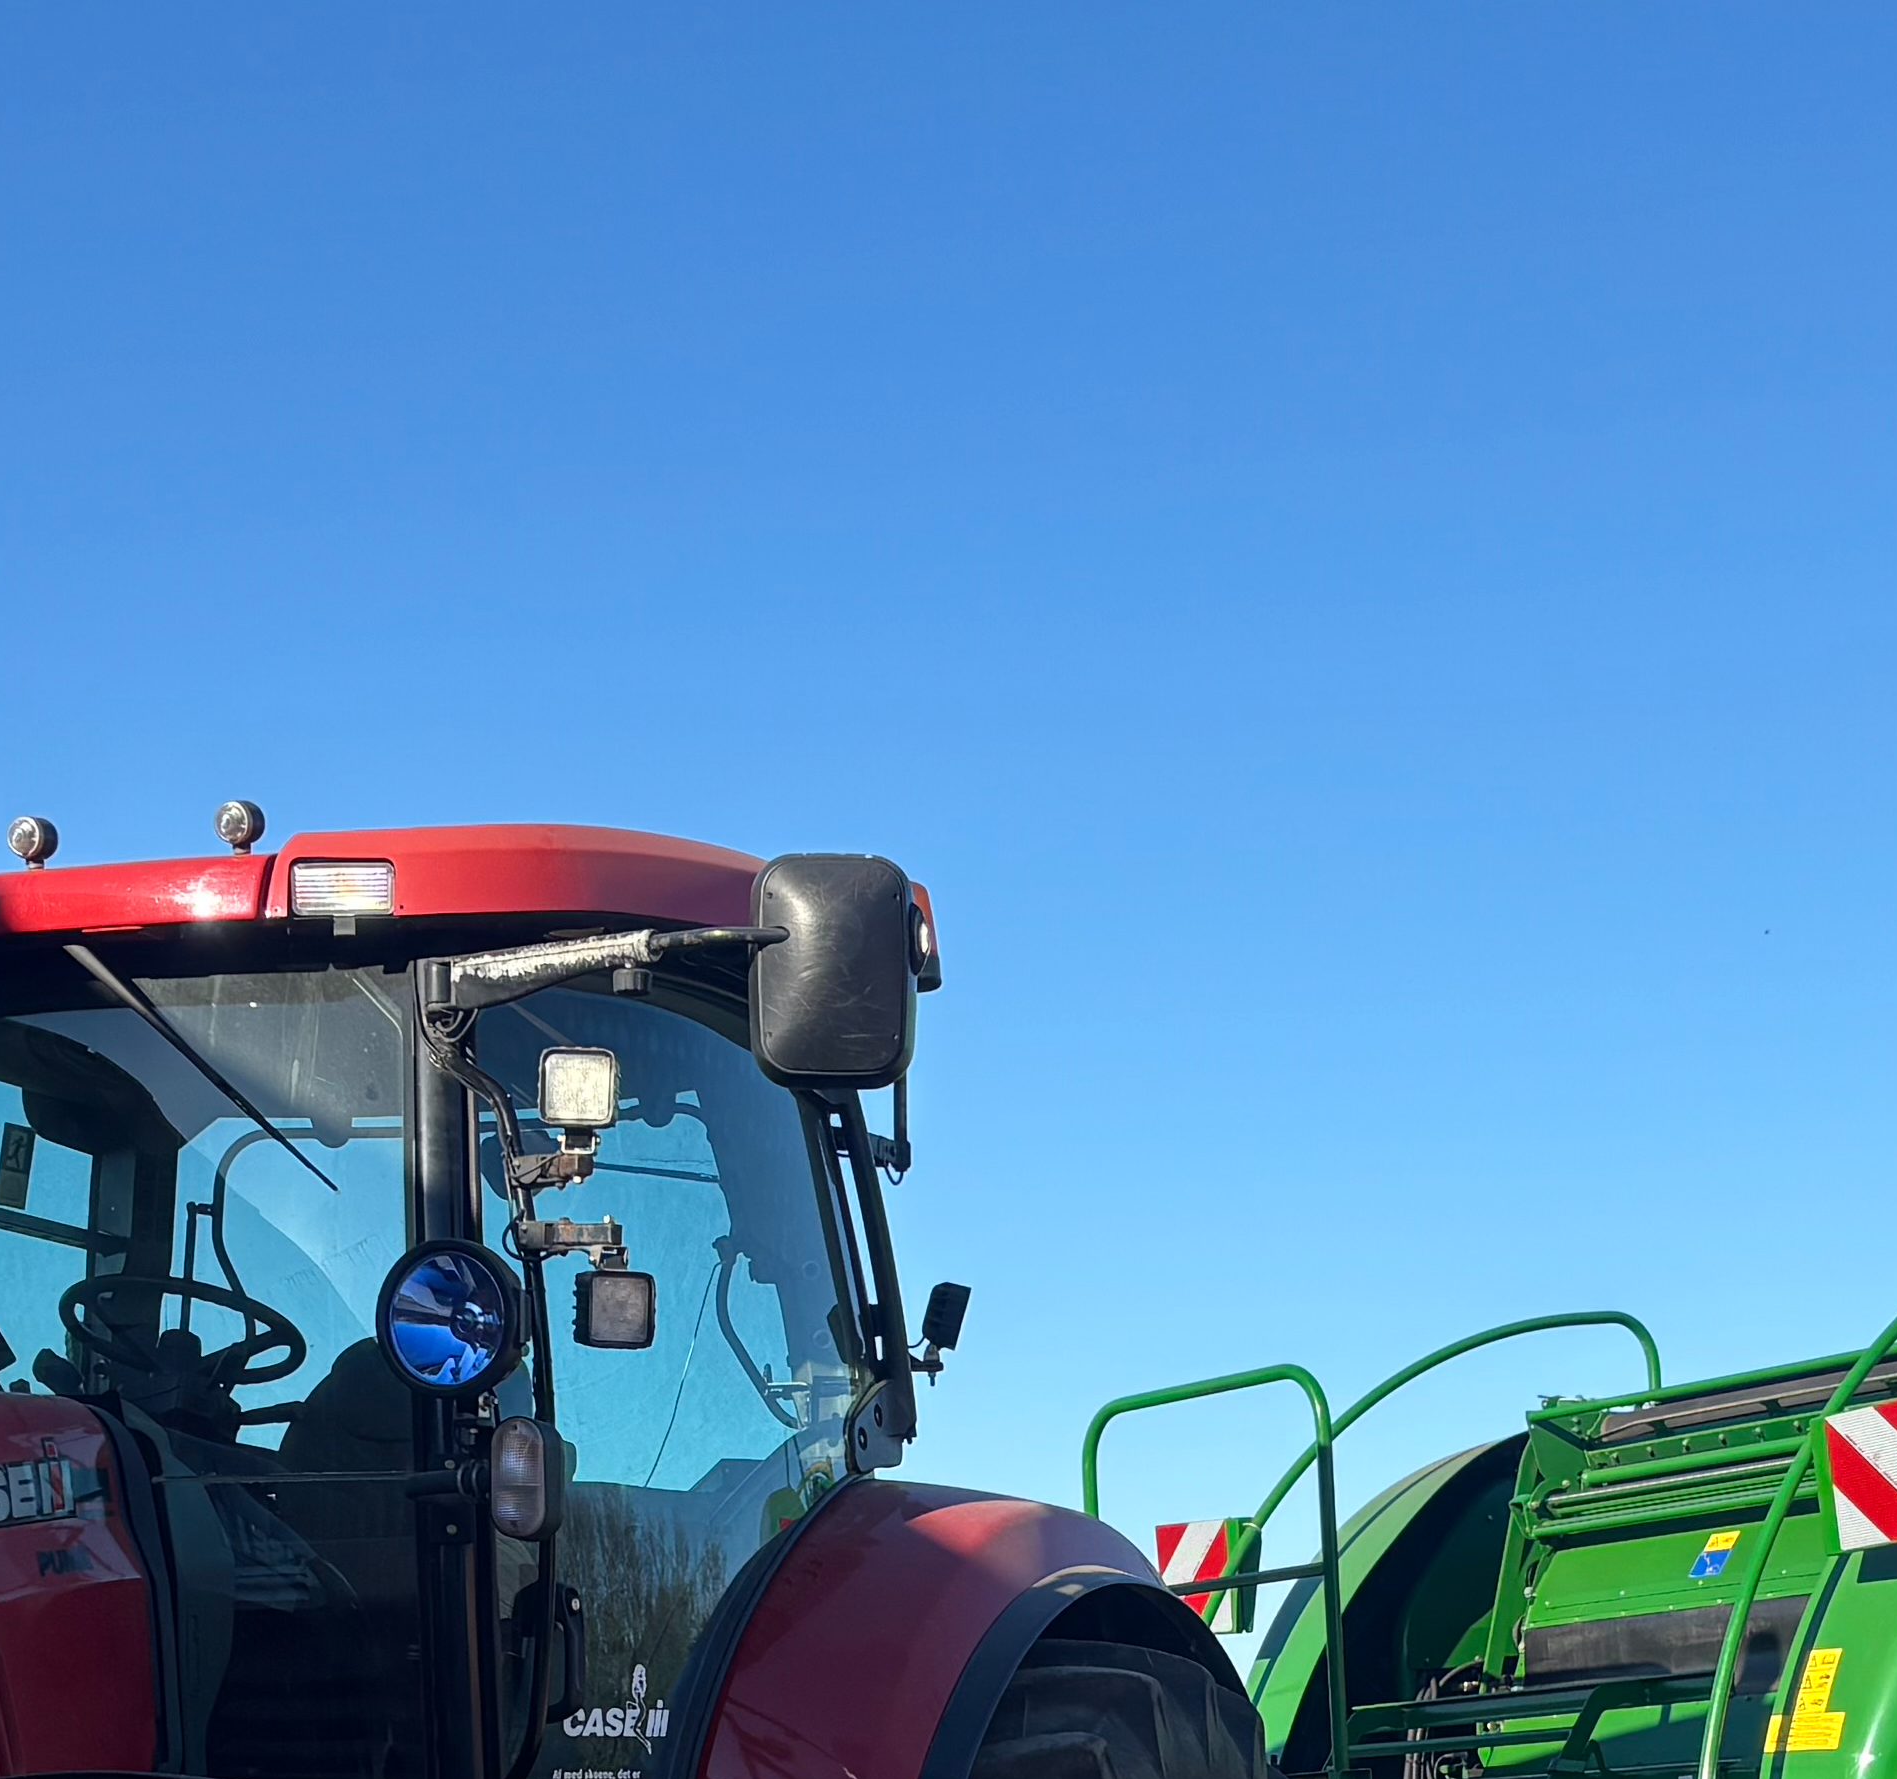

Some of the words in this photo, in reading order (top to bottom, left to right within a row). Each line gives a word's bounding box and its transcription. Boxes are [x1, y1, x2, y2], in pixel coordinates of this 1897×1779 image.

[563, 1706, 639, 1738] CASE
[617, 1768, 631, 1779] det
[632, 1769, 641, 1779] er
